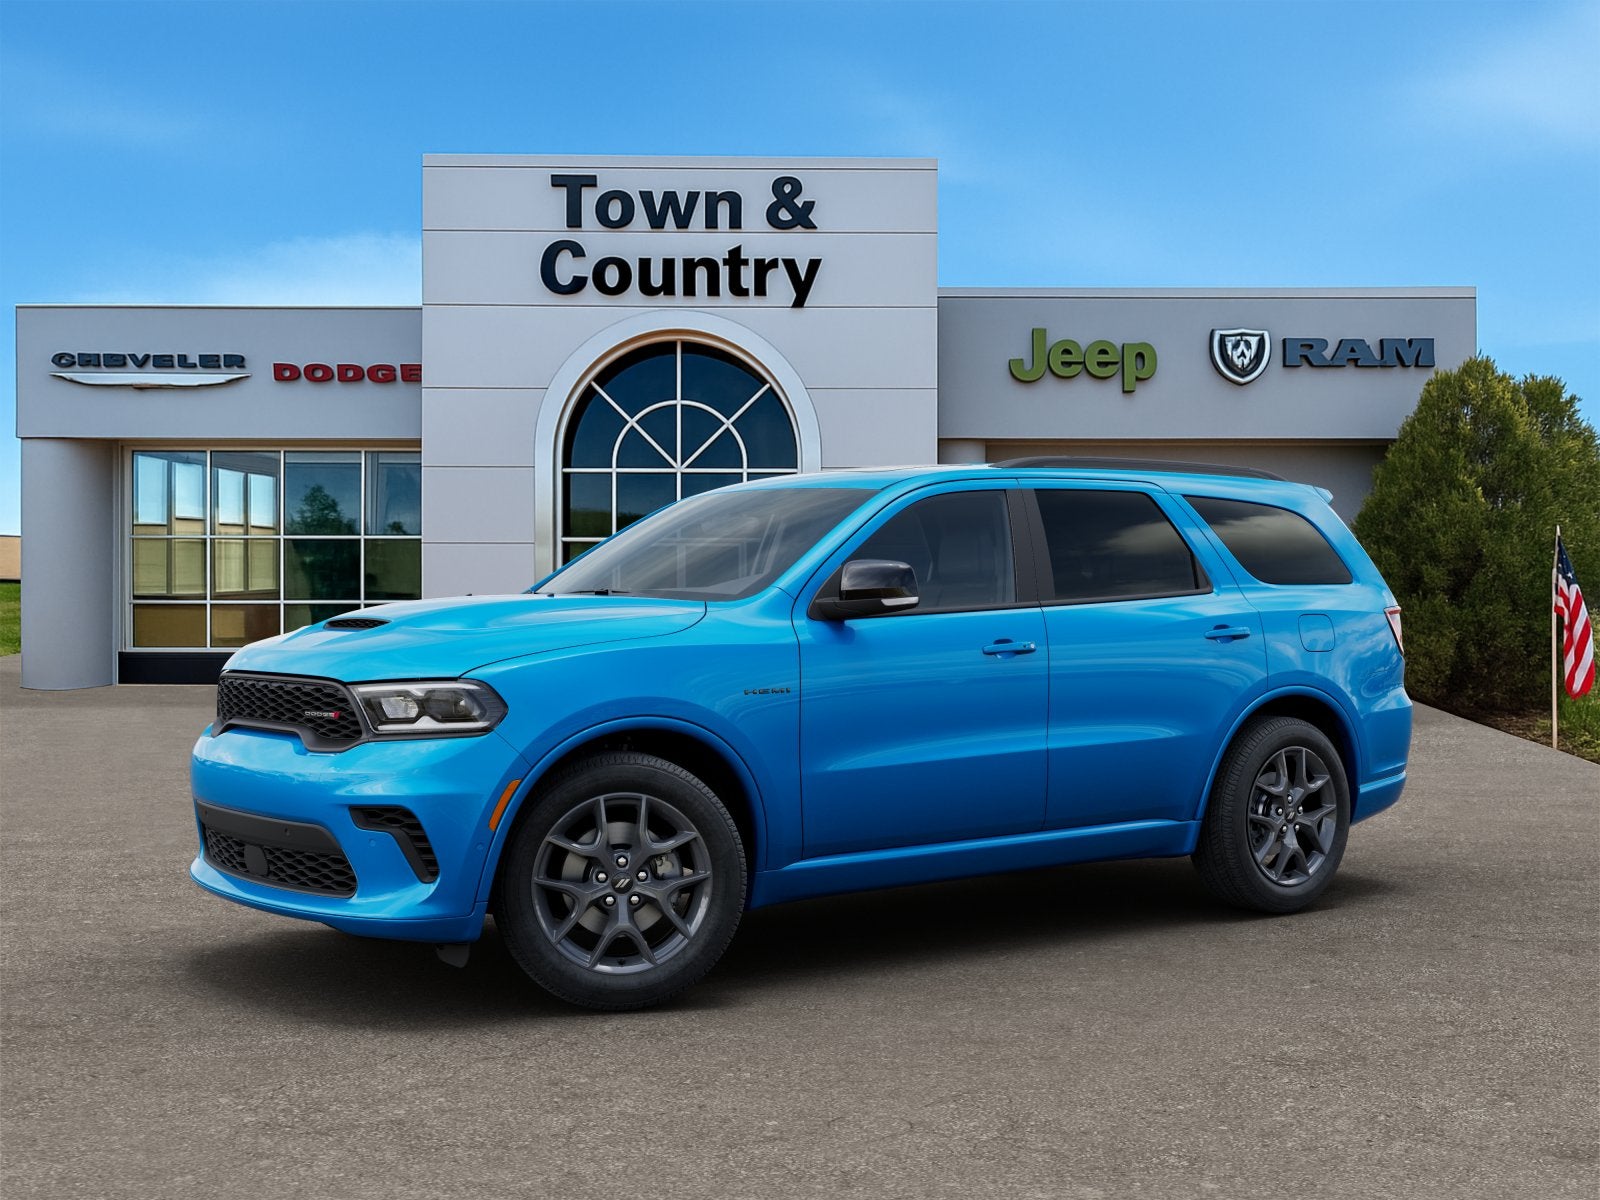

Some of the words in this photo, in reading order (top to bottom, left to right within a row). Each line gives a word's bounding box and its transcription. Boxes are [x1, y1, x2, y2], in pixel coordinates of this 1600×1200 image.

[550, 174, 743, 230] Town
[765, 175, 818, 230] &
[540, 239, 822, 308] Country
[272, 362, 422, 384] DODGE
[1009, 327, 1158, 393] Jeep
[1282, 337, 1436, 367] RAM
[304, 710, 335, 718] DODGE
